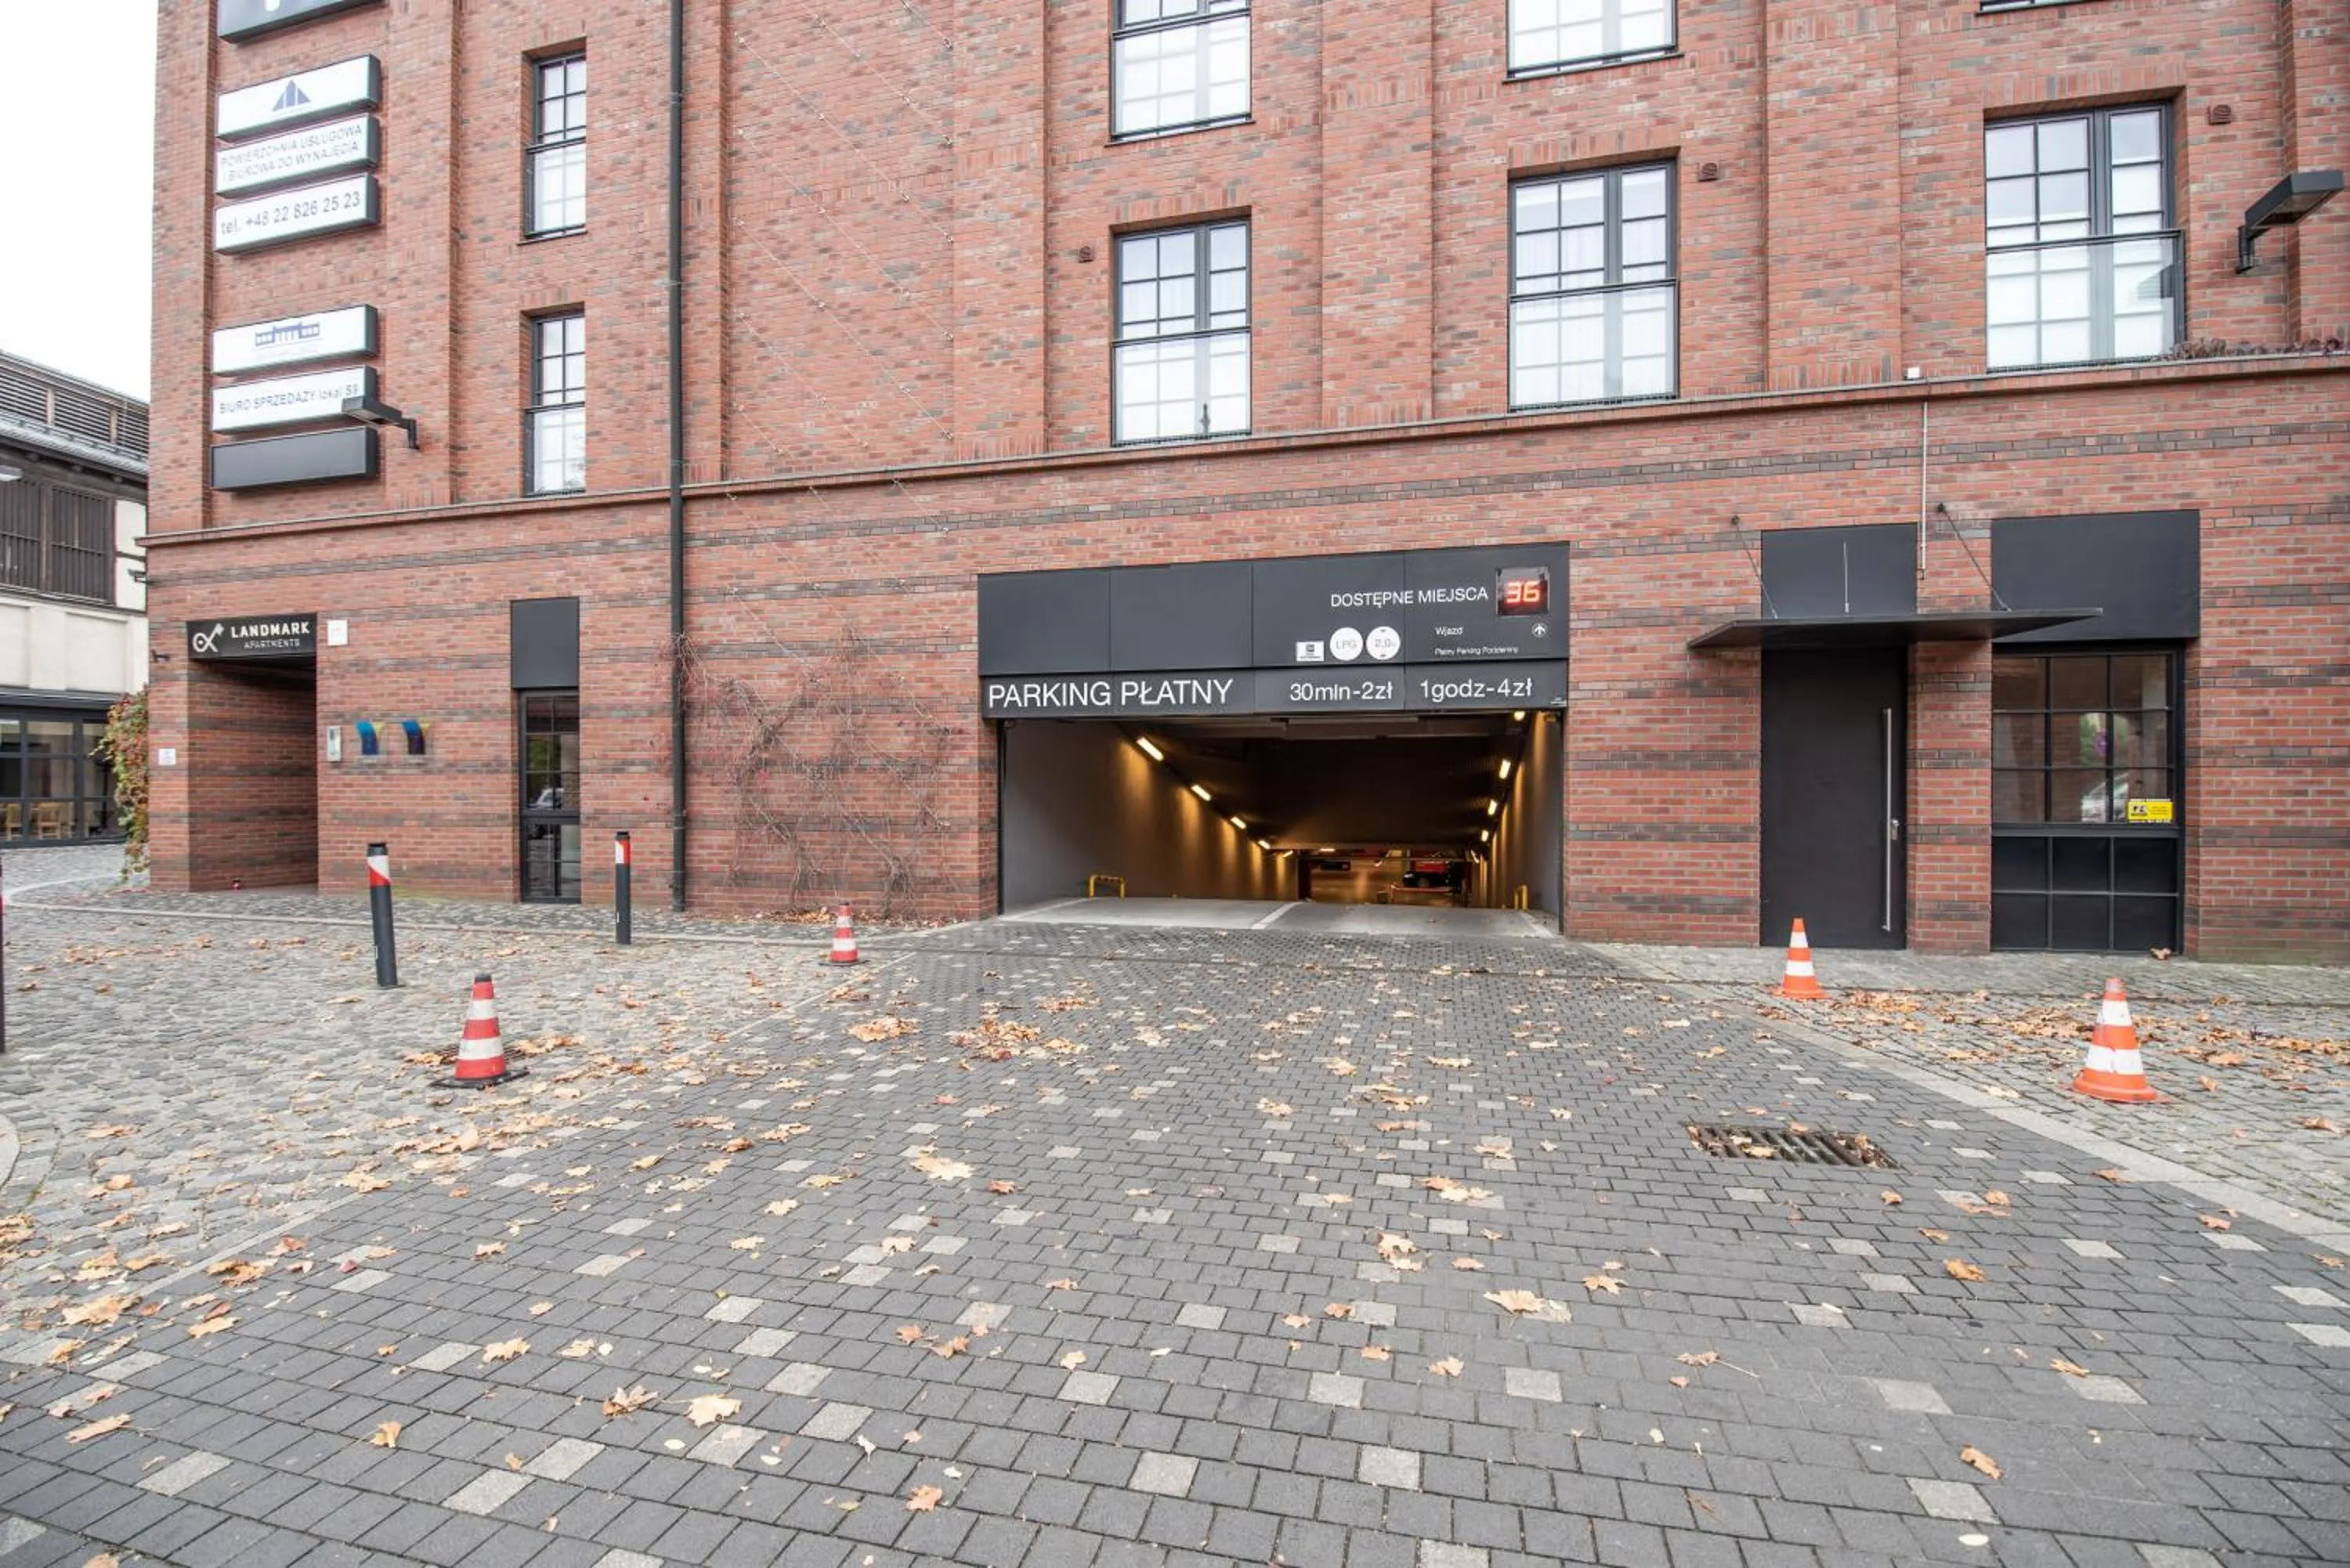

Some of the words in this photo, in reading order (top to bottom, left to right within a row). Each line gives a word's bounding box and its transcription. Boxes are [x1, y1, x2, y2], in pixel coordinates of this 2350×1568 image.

[245, 210, 269, 227] +48
[273, 206, 289, 223] 22
[294, 201, 317, 219] 826
[323, 196, 339, 213] 25
[344, 191, 361, 209] 23
[219, 399, 251, 414] BIURO
[1331, 591, 1414, 609] DOSTĘPNE
[1418, 586, 1489, 604] MIEJSCA
[1505, 580, 1542, 604] 36
[231, 621, 310, 638] LANDMARK
[1435, 627, 1463, 636] Wjazd
[244, 638, 300, 649] APARTMENTS
[1336, 638, 1358, 649] LPG
[989, 682, 1112, 708] PARKING
[1121, 679, 1234, 705] PŁATNY
[1419, 677, 1533, 703] 1godz-4zł
